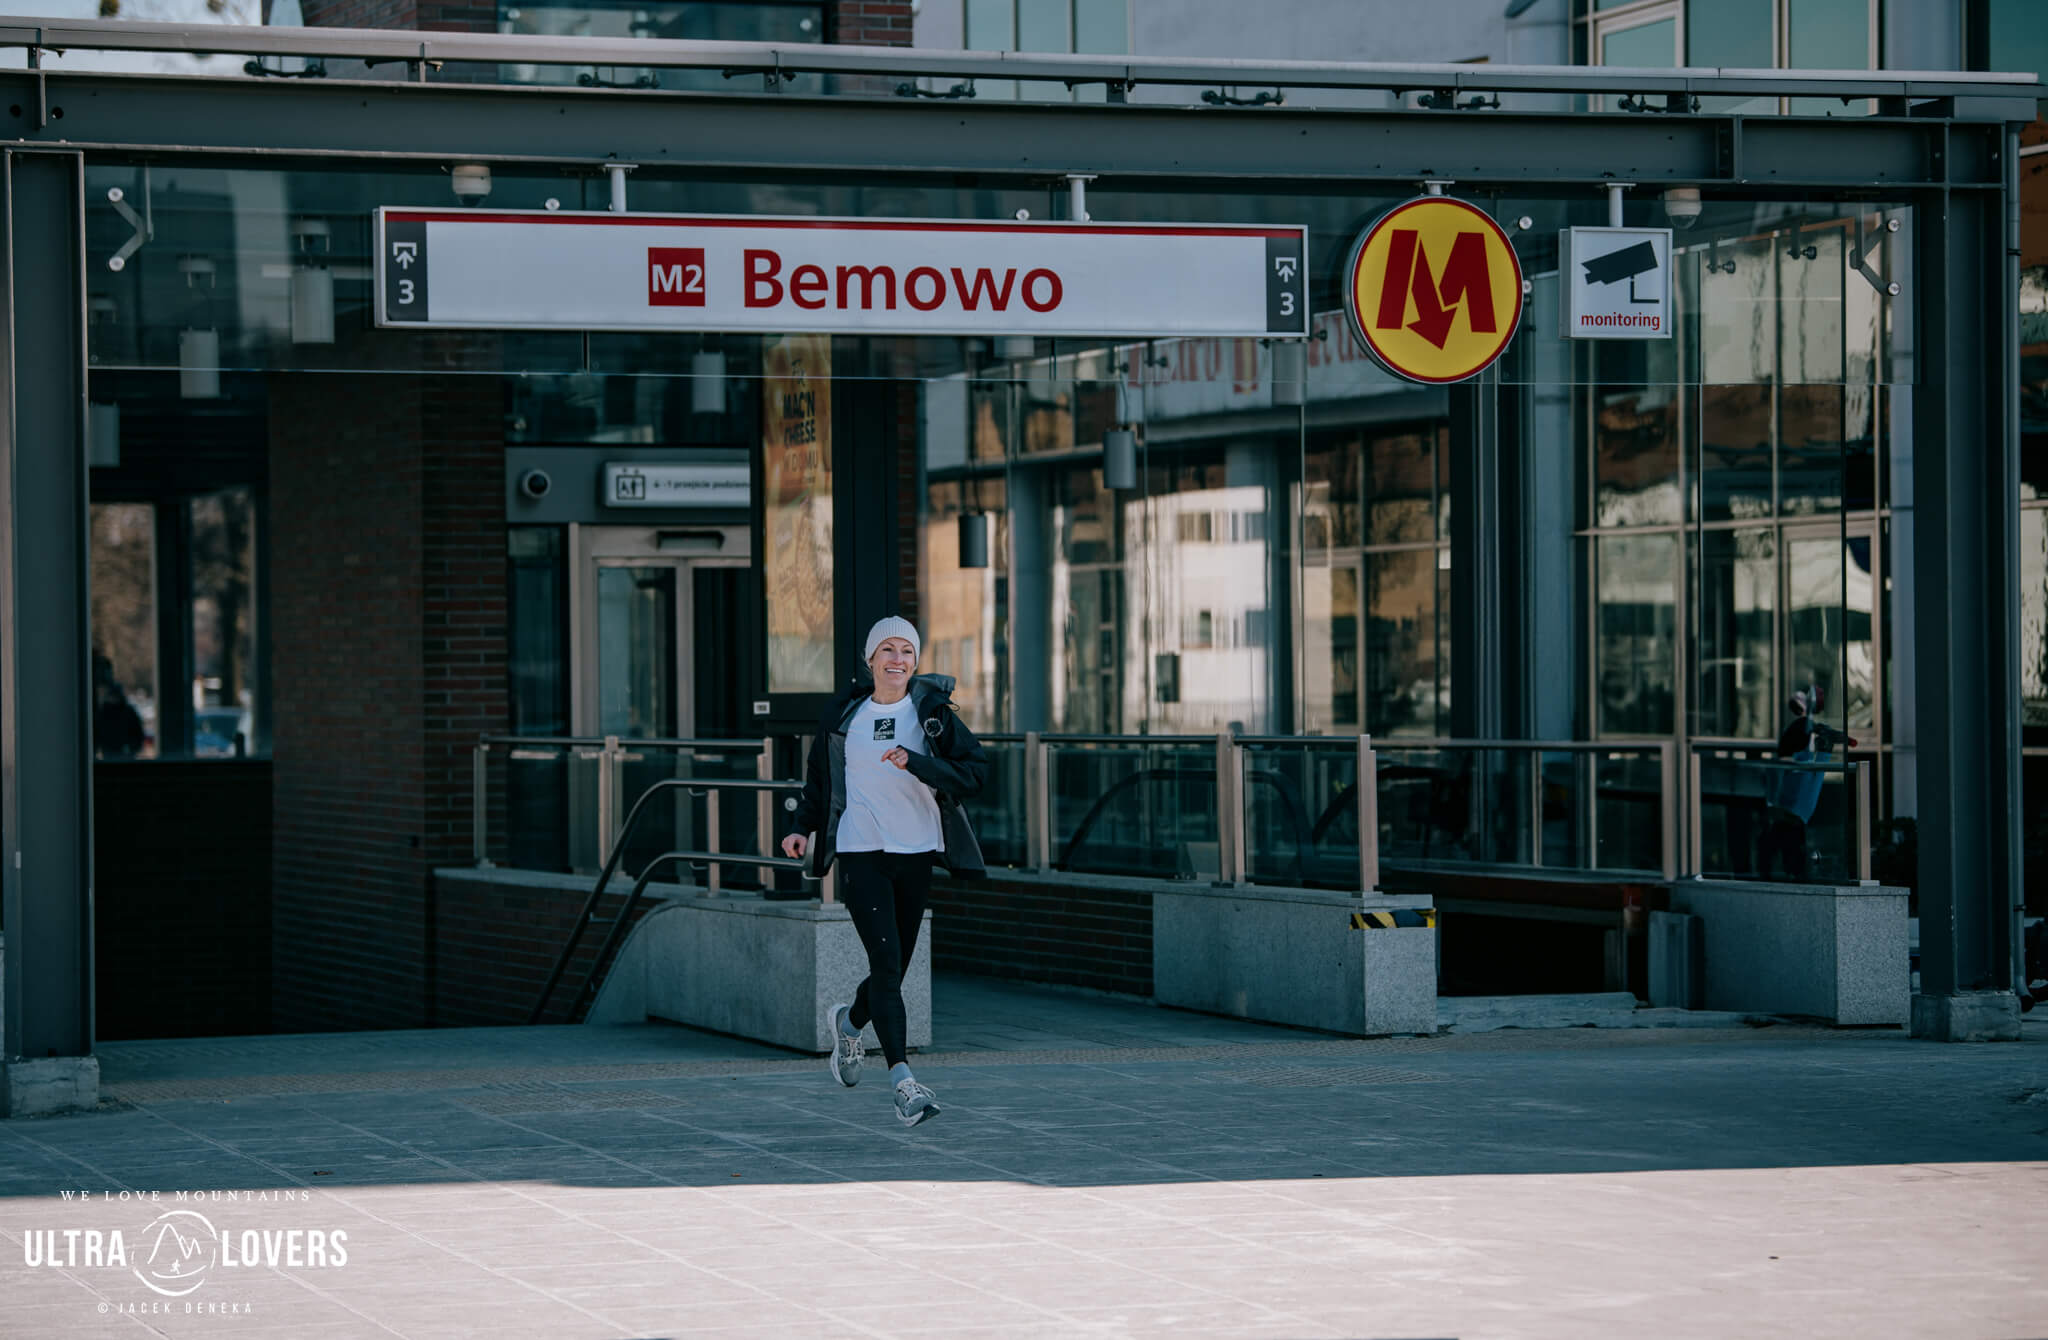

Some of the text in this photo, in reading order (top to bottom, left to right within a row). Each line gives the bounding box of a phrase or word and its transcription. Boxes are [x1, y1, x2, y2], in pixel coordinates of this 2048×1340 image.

[398, 279, 415, 304] 3
[651, 249, 1064, 313] M2 Bemowo
[1279, 291, 1295, 316] 3
[1580, 312, 1661, 331] monitoring
